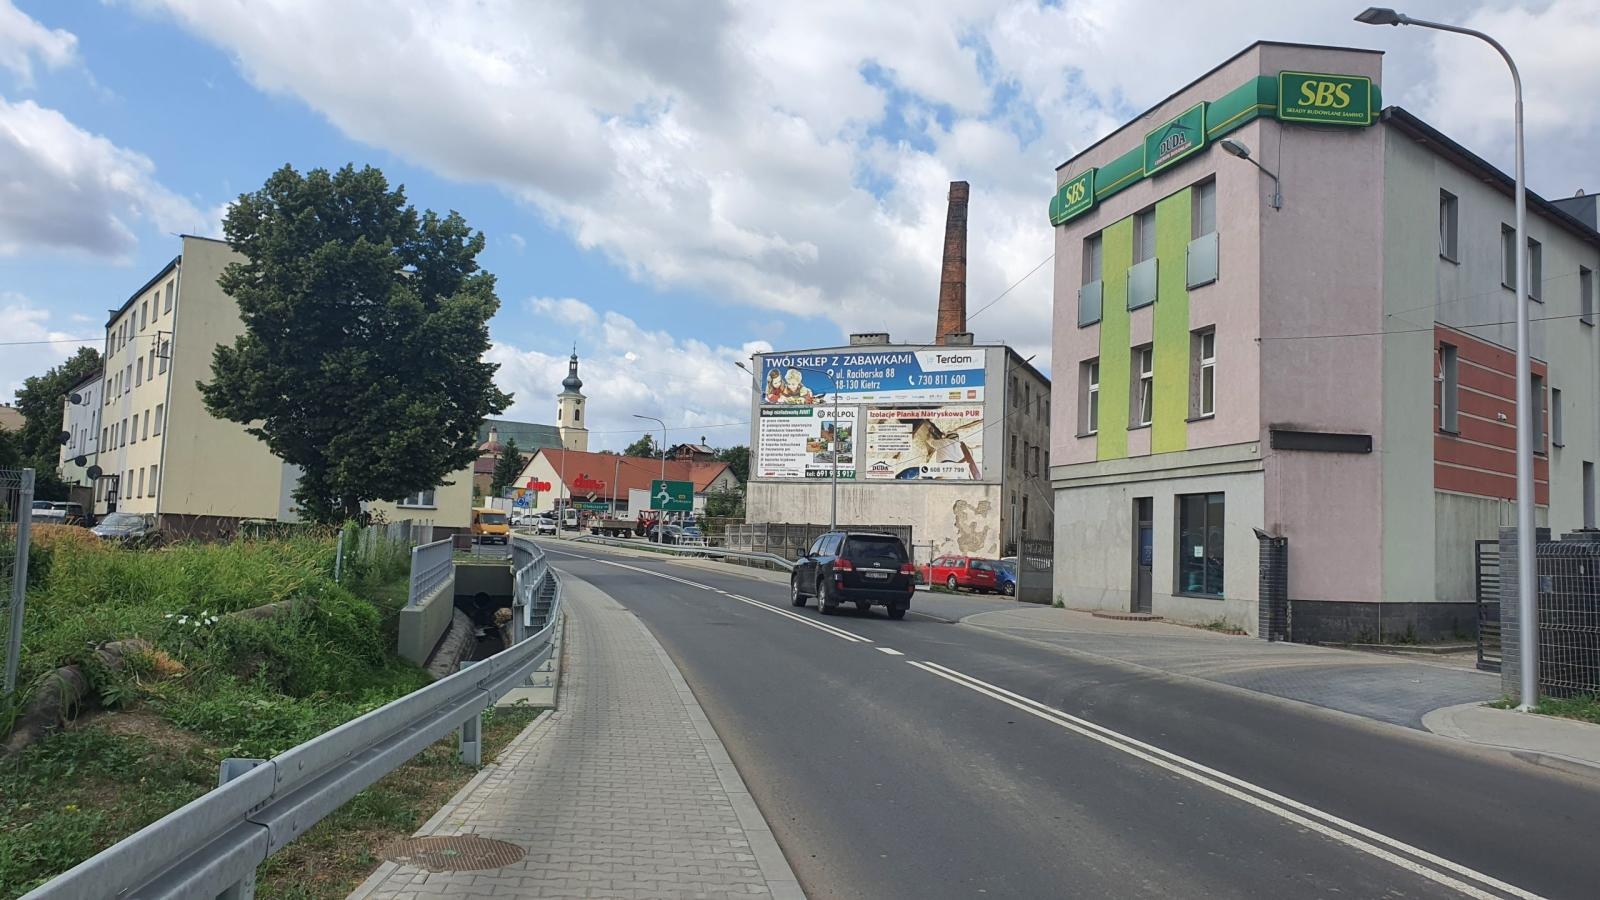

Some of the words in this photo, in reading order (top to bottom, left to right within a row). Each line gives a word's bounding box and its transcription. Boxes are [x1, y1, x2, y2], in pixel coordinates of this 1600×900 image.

[1298, 80, 1352, 108] SBS
[1160, 132, 1186, 156] DUDA
[1065, 178, 1085, 208] SBS
[766, 355, 795, 367] TWÓJ
[797, 356, 828, 367] SKLEP
[832, 356, 839, 366] Z
[844, 354, 912, 366] ZABAWKAMI
[936, 354, 972, 364] Terdom
[836, 369, 845, 379] ul.
[847, 367, 883, 379] Raciborska
[886, 367, 895, 378] 88
[860, 380, 881, 390] Kietrz
[918, 375, 933, 386] 730
[935, 375, 948, 385] 811
[951, 374, 966, 385] 600
[827, 410, 855, 418] ROLPOL
[870, 411, 896, 419] Izolacje
[574, 473, 605, 489] dino
